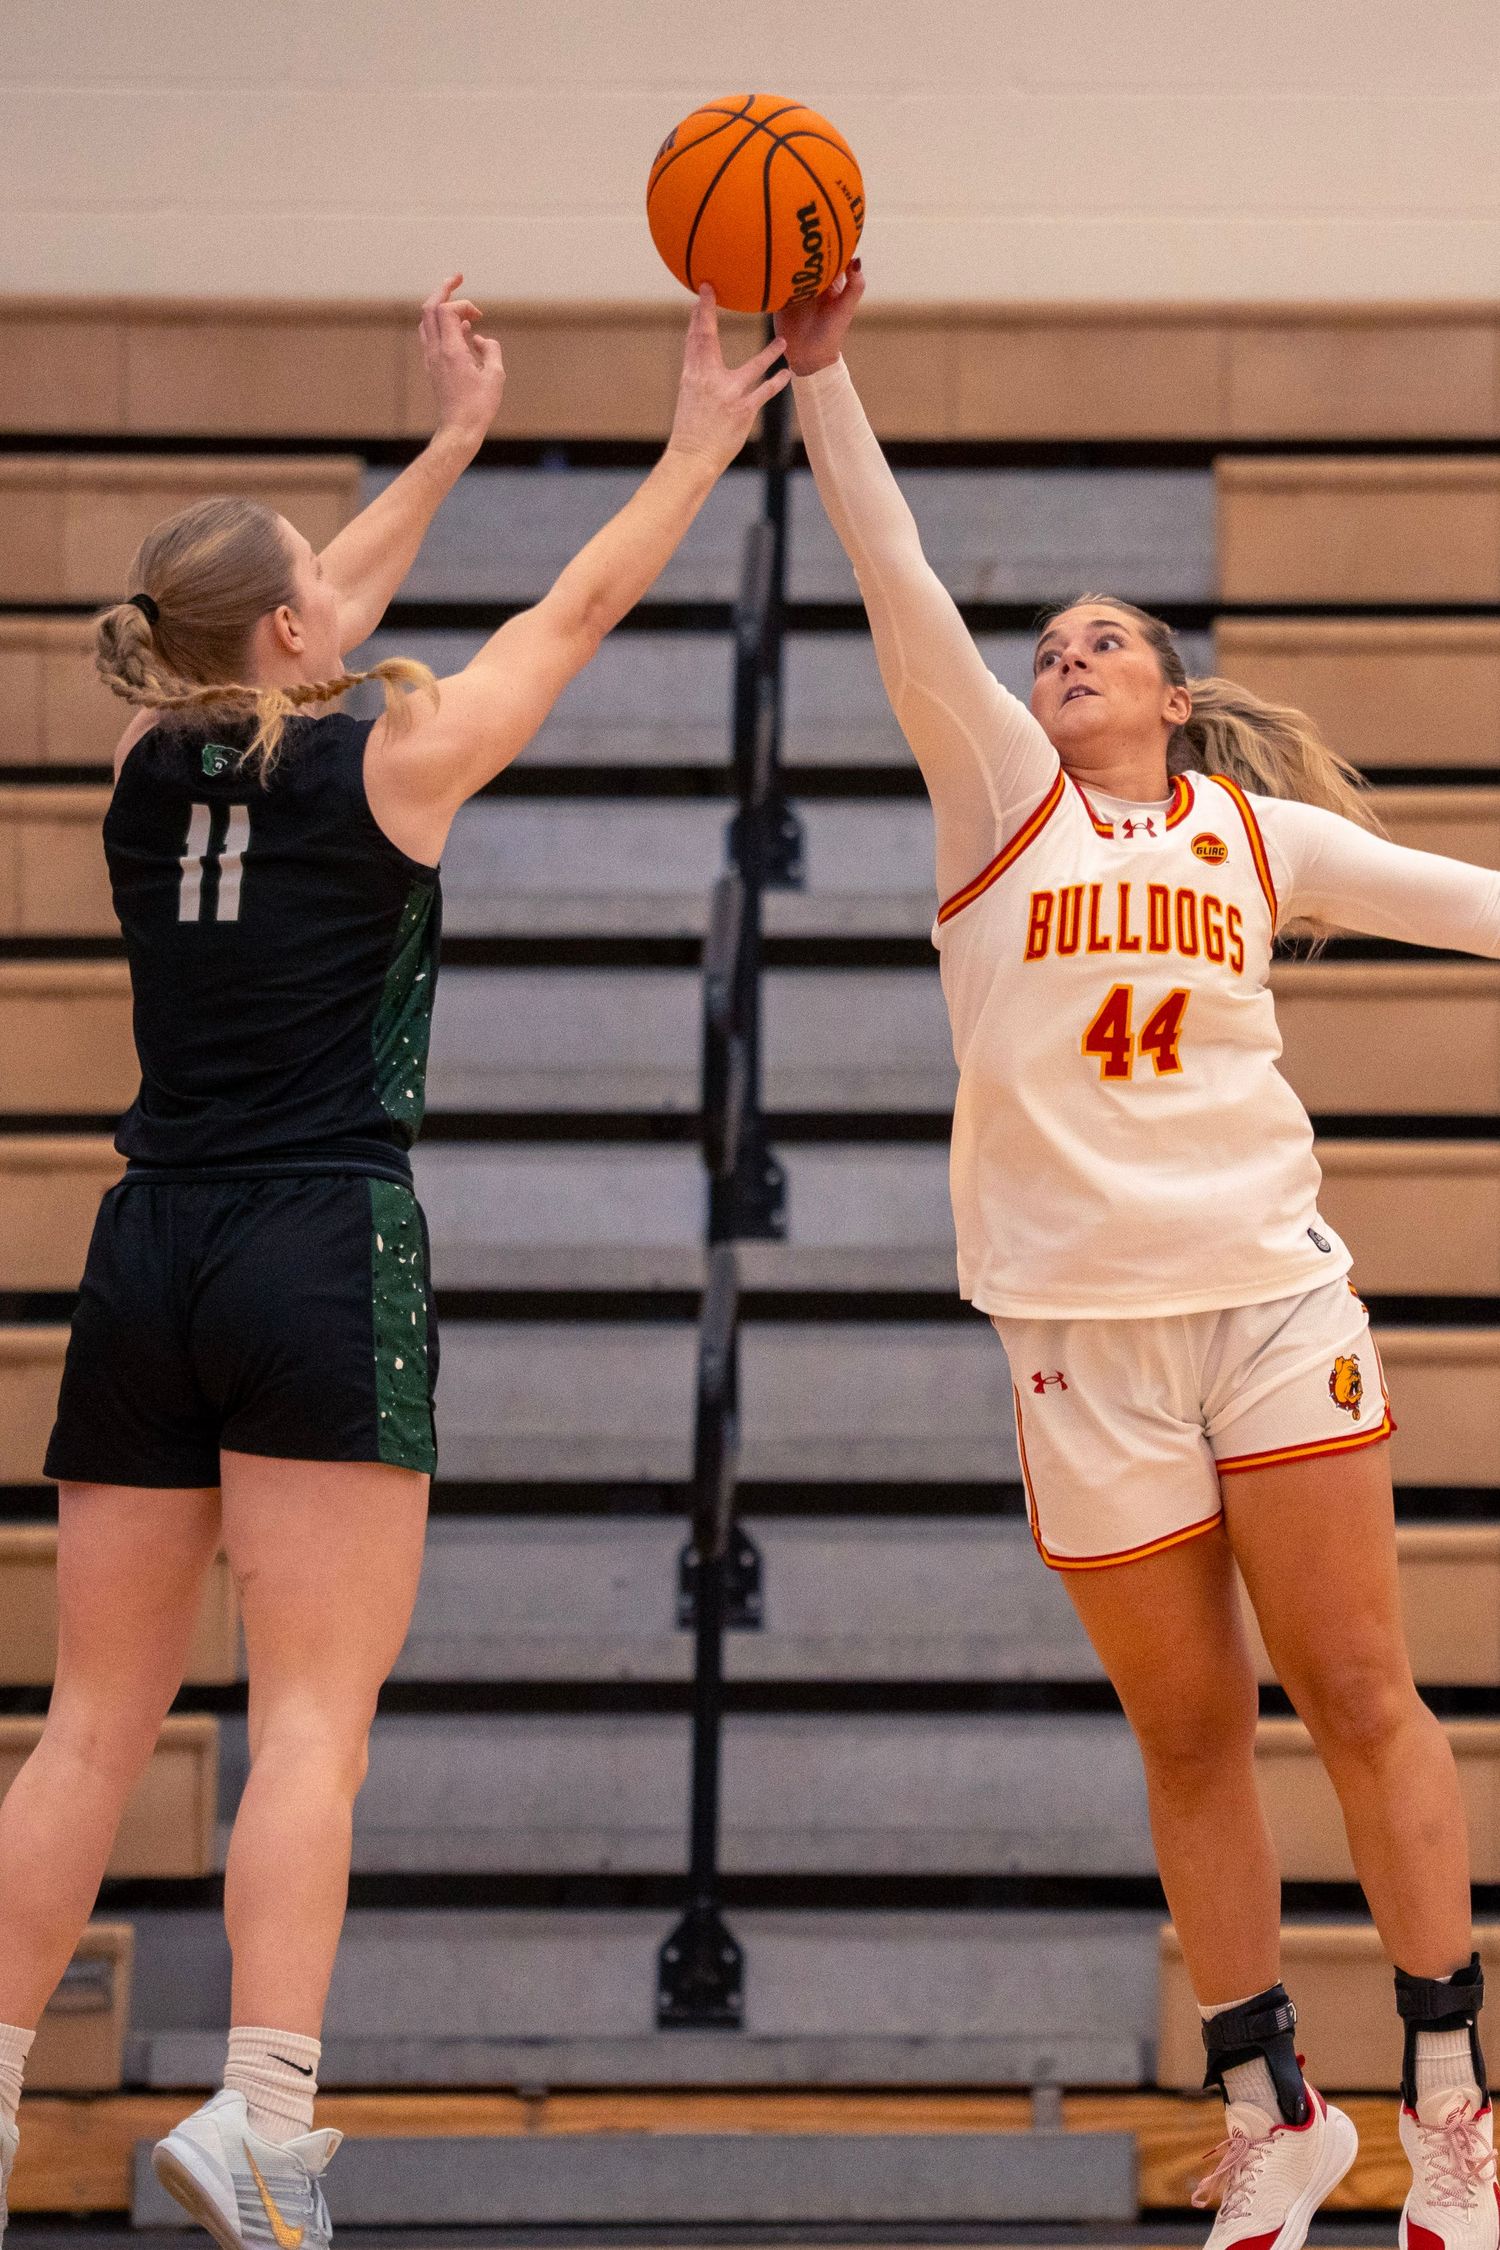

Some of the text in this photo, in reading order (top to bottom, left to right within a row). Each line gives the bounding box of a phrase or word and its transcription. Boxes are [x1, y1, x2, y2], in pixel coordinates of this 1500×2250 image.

[178, 803, 250, 922] 11
[1196, 846, 1225, 856] GLIAC
[1023, 882, 1245, 977] BULLDOGS
[1081, 983, 1191, 1081] 44
